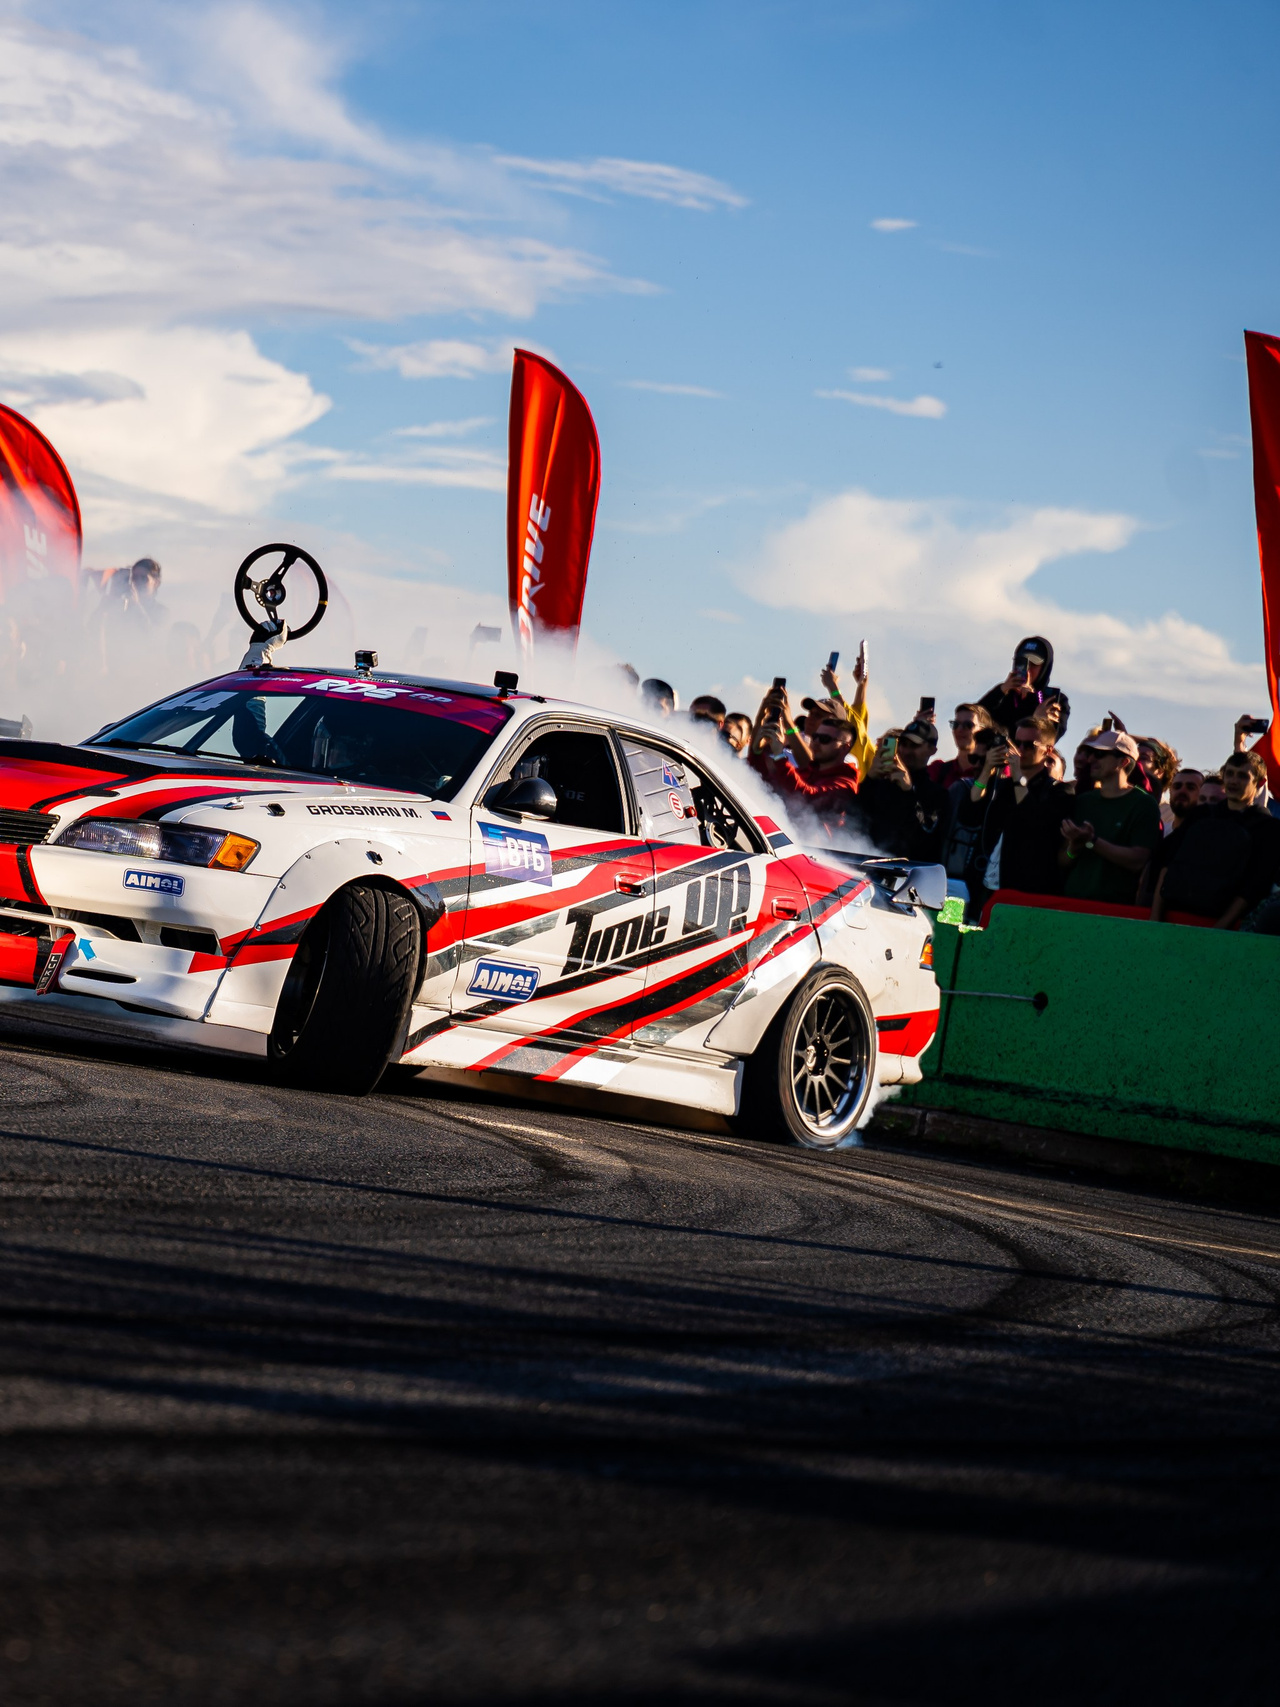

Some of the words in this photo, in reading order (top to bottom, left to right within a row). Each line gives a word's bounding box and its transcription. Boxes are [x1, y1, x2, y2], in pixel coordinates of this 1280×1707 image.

[301, 678, 414, 700] RDS
[306, 805, 402, 818] GROSSMAN
[401, 807, 423, 819] M.
[505, 836, 545, 873] ВТБ
[126, 873, 182, 891] AIMOL
[560, 905, 671, 978] Time
[471, 968, 533, 993] AIMOL
